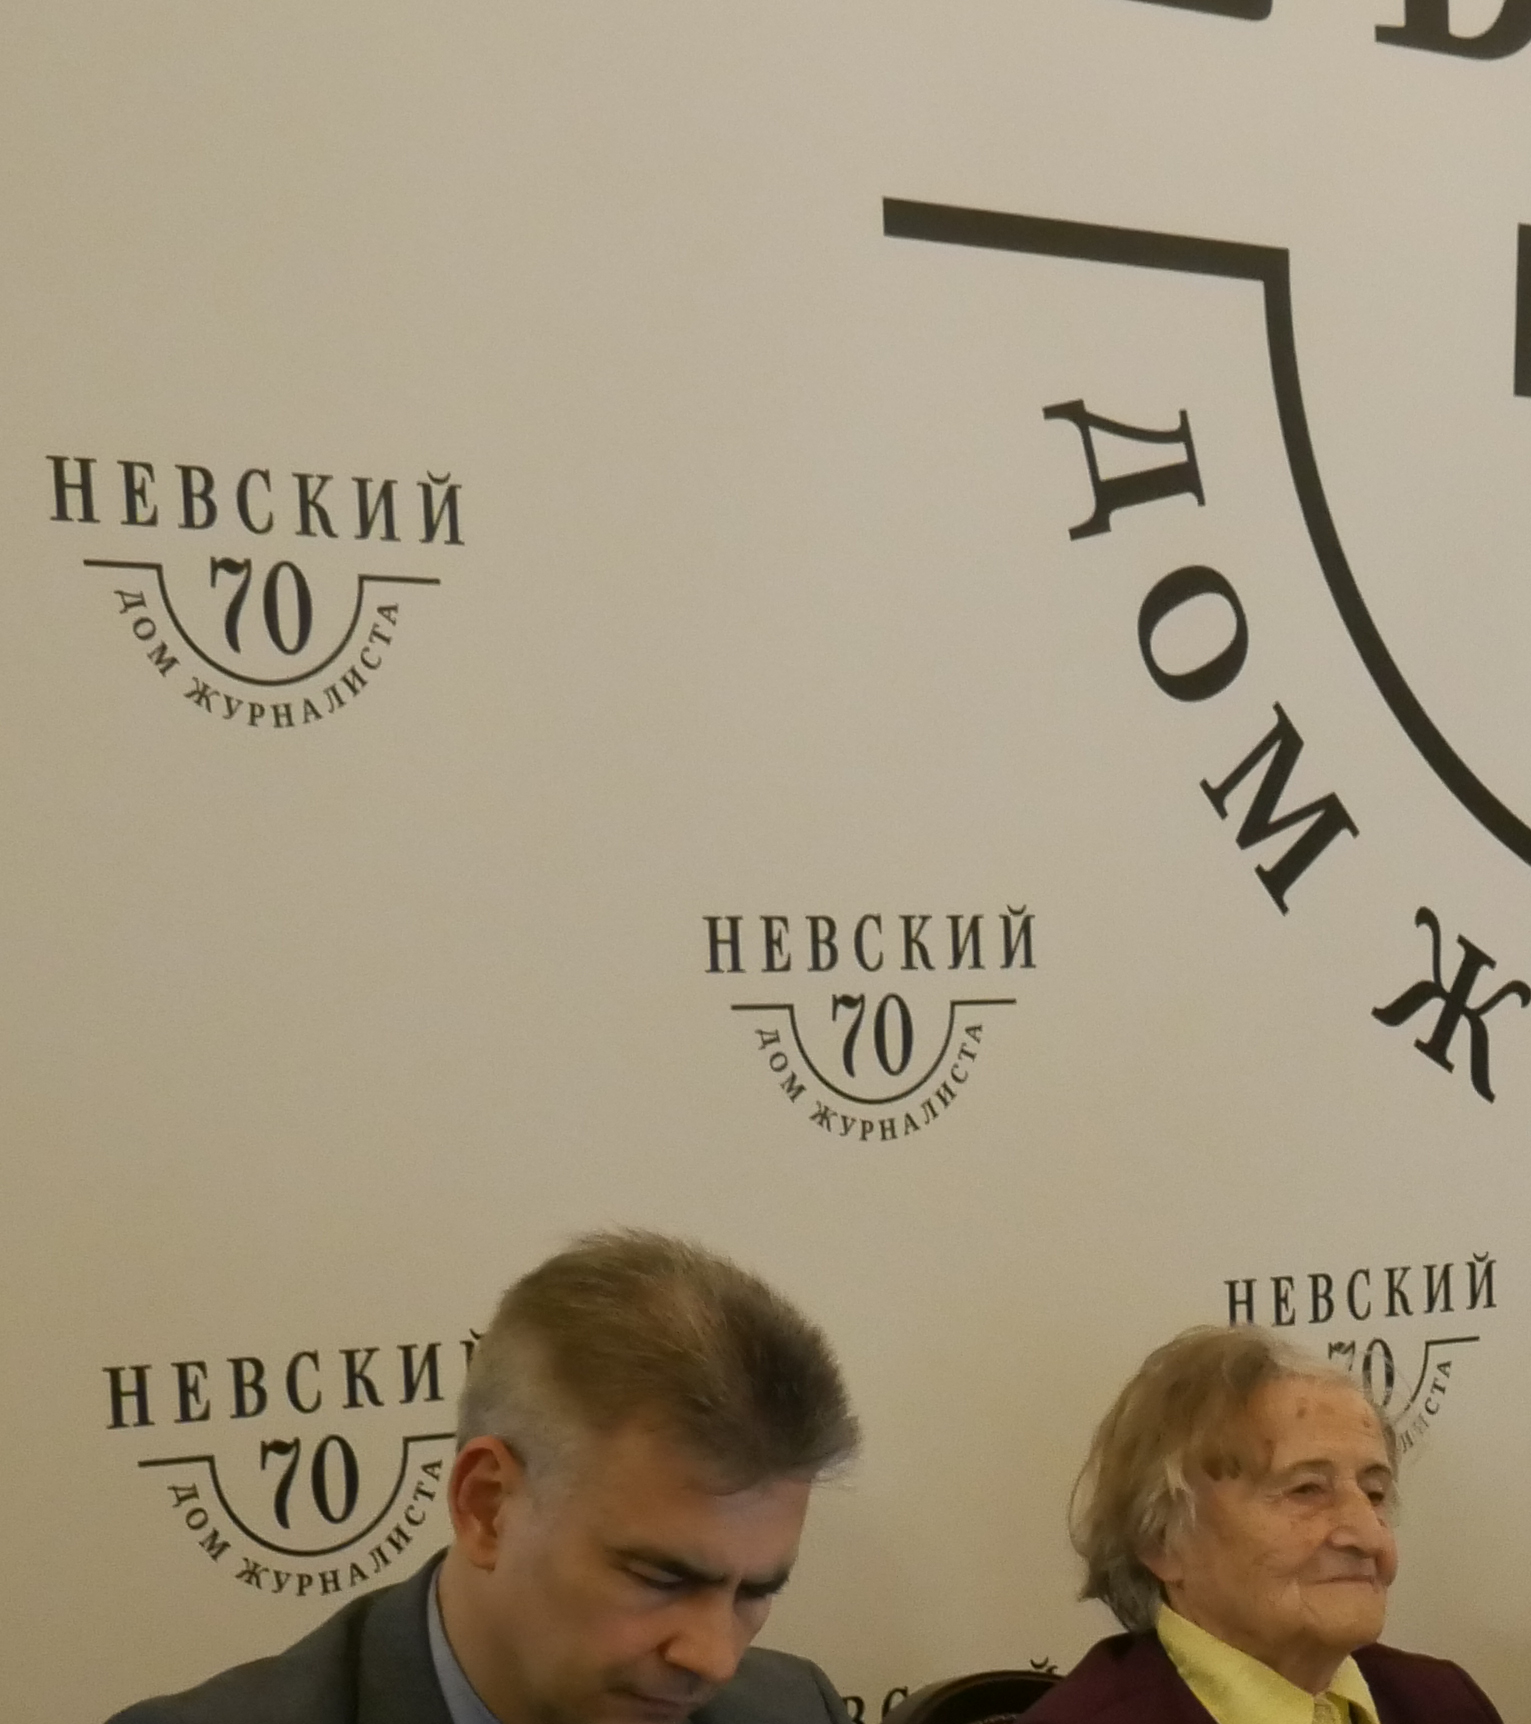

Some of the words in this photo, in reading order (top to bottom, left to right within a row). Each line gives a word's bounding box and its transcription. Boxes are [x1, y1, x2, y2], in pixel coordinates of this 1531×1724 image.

[45, 455, 466, 546] НЕВСКИЙ
[209, 555, 313, 656] 70
[114, 589, 180, 677] ДОМ
[184, 601, 400, 729] ЖУРНАЛИСТА
[1042, 398, 1360, 914] ДОМ
[702, 904, 1037, 974] НЕВСКИЙ
[755, 1028, 807, 1103] ДОМ
[809, 1022, 983, 1142] ЖУРНАЛИСТА
[831, 992, 914, 1079] 70
[1223, 1251, 1498, 1328] НЕВСКИЙ
[167, 1481, 230, 1563] ДОМ
[235, 1458, 444, 1598] ЖУРНАЛИСТА
[259, 1433, 361, 1530] 70
